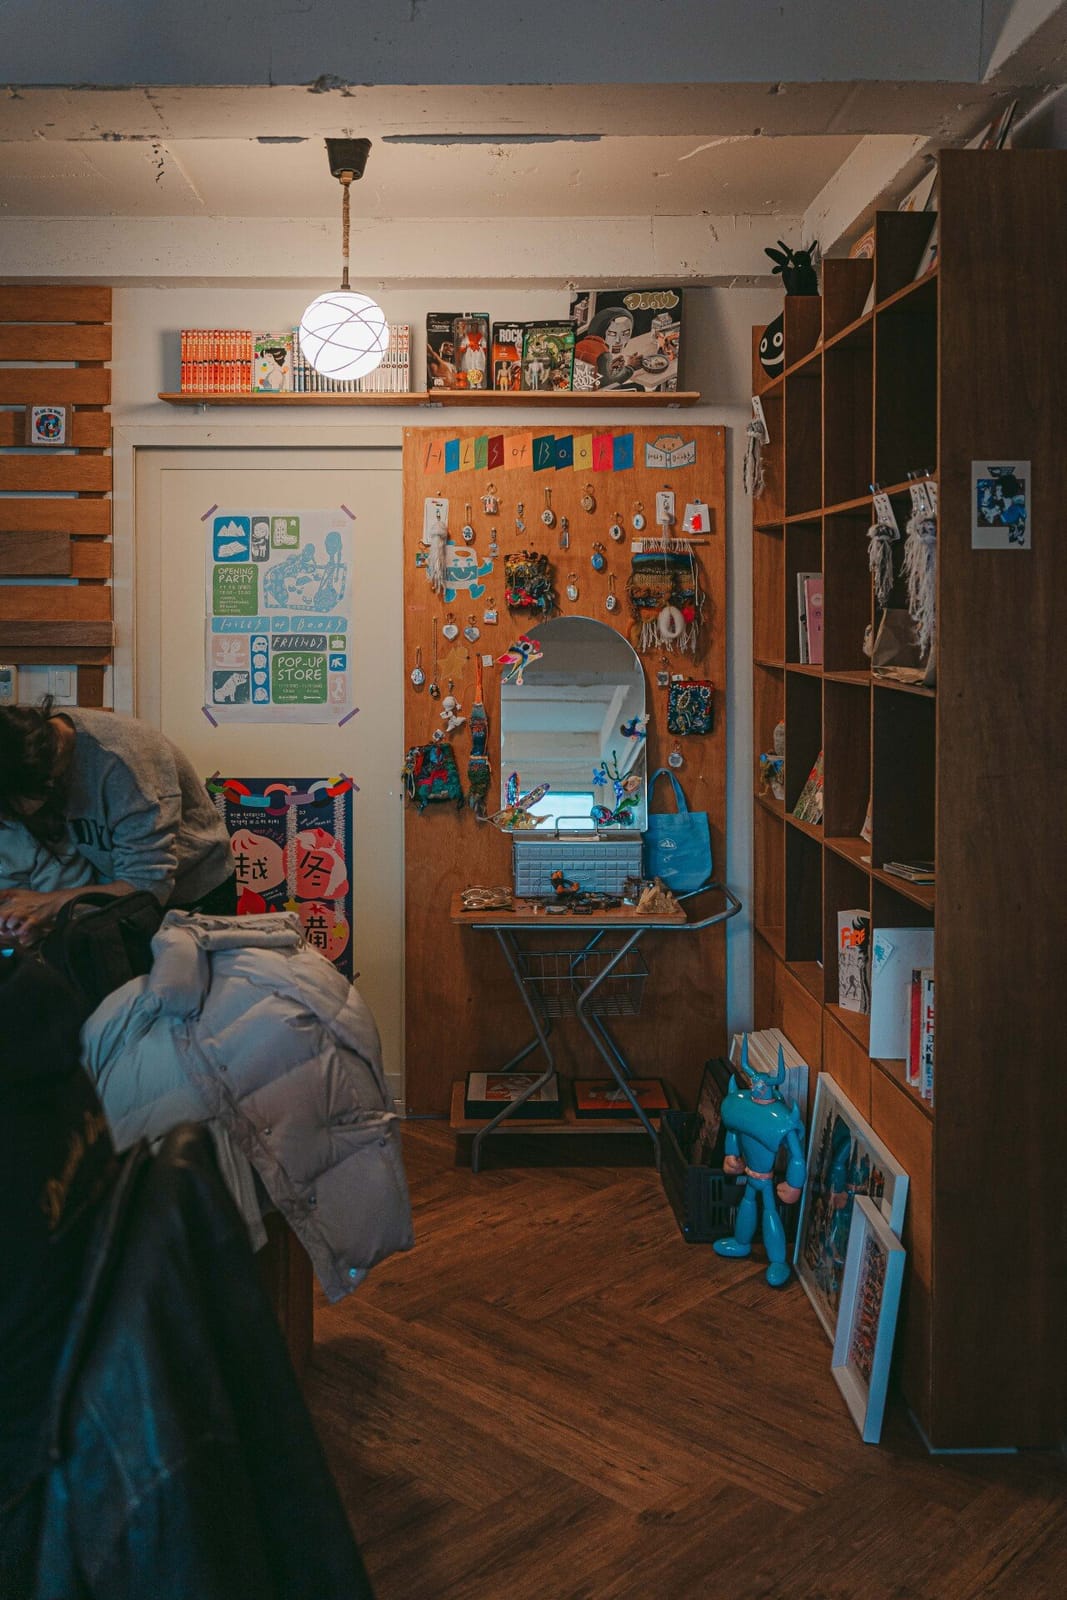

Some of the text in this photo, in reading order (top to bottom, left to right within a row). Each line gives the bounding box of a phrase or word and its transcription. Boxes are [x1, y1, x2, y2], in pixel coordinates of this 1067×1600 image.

[218, 566, 254, 575] OPENING
[218, 574, 254, 584] PARTY
[273, 636, 324, 649] FRIENDS
[278, 656, 324, 668] POP-UP
[277, 668, 322, 681] STORE
[299, 851, 332, 887] 冬
